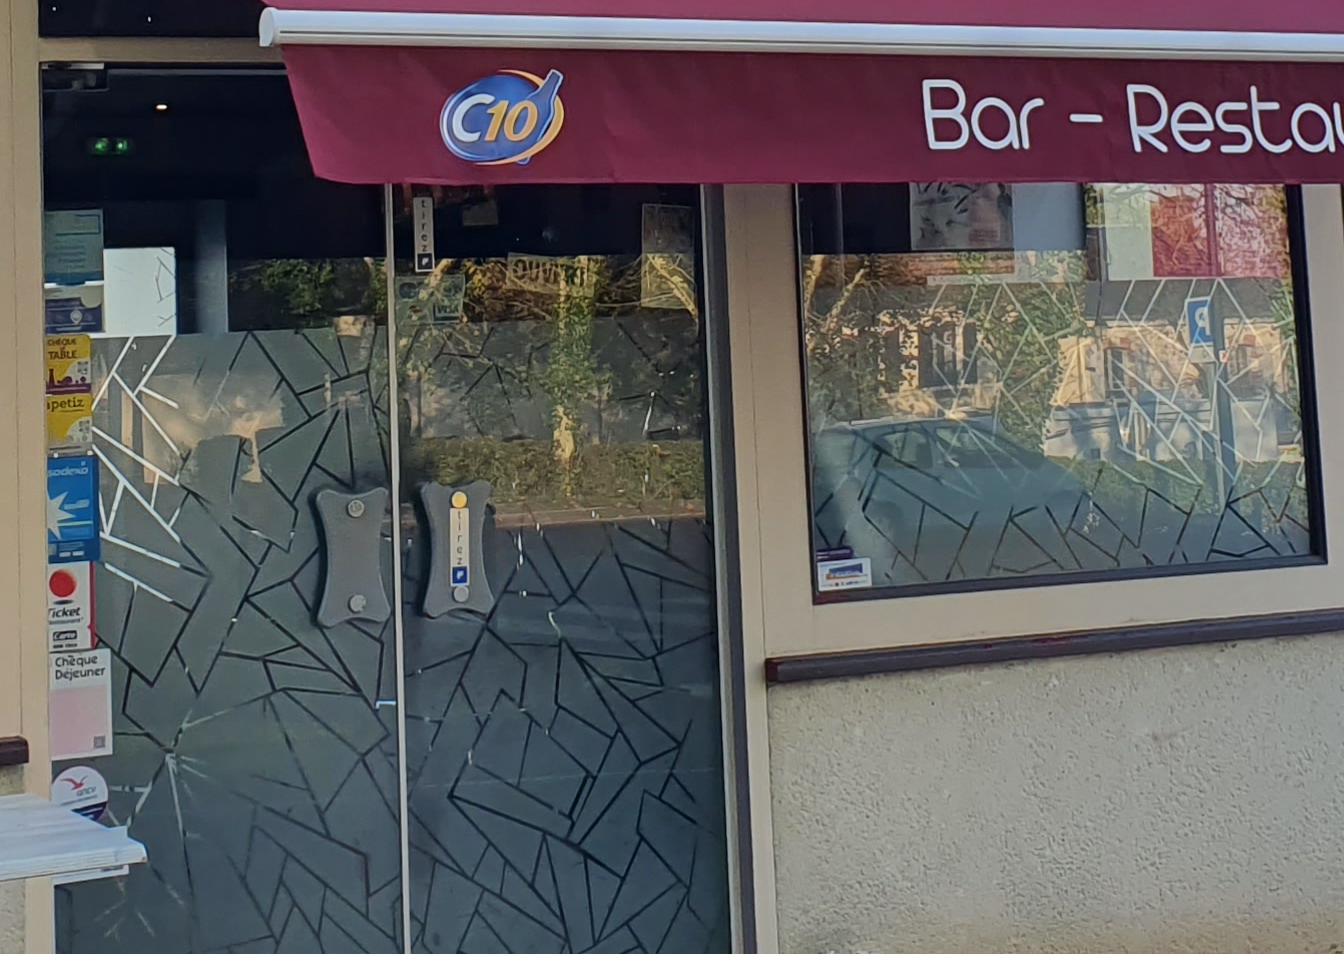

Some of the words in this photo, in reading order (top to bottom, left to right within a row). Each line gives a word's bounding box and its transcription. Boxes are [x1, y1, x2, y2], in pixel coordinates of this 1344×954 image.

[452, 93, 538, 143] C10
[922, 79, 1044, 150] Bar
[420, 199, 428, 252] tirez
[48, 350, 78, 360] TABLE
[49, 607, 81, 618] Ticket
[56, 667, 106, 681] Déjeuner
